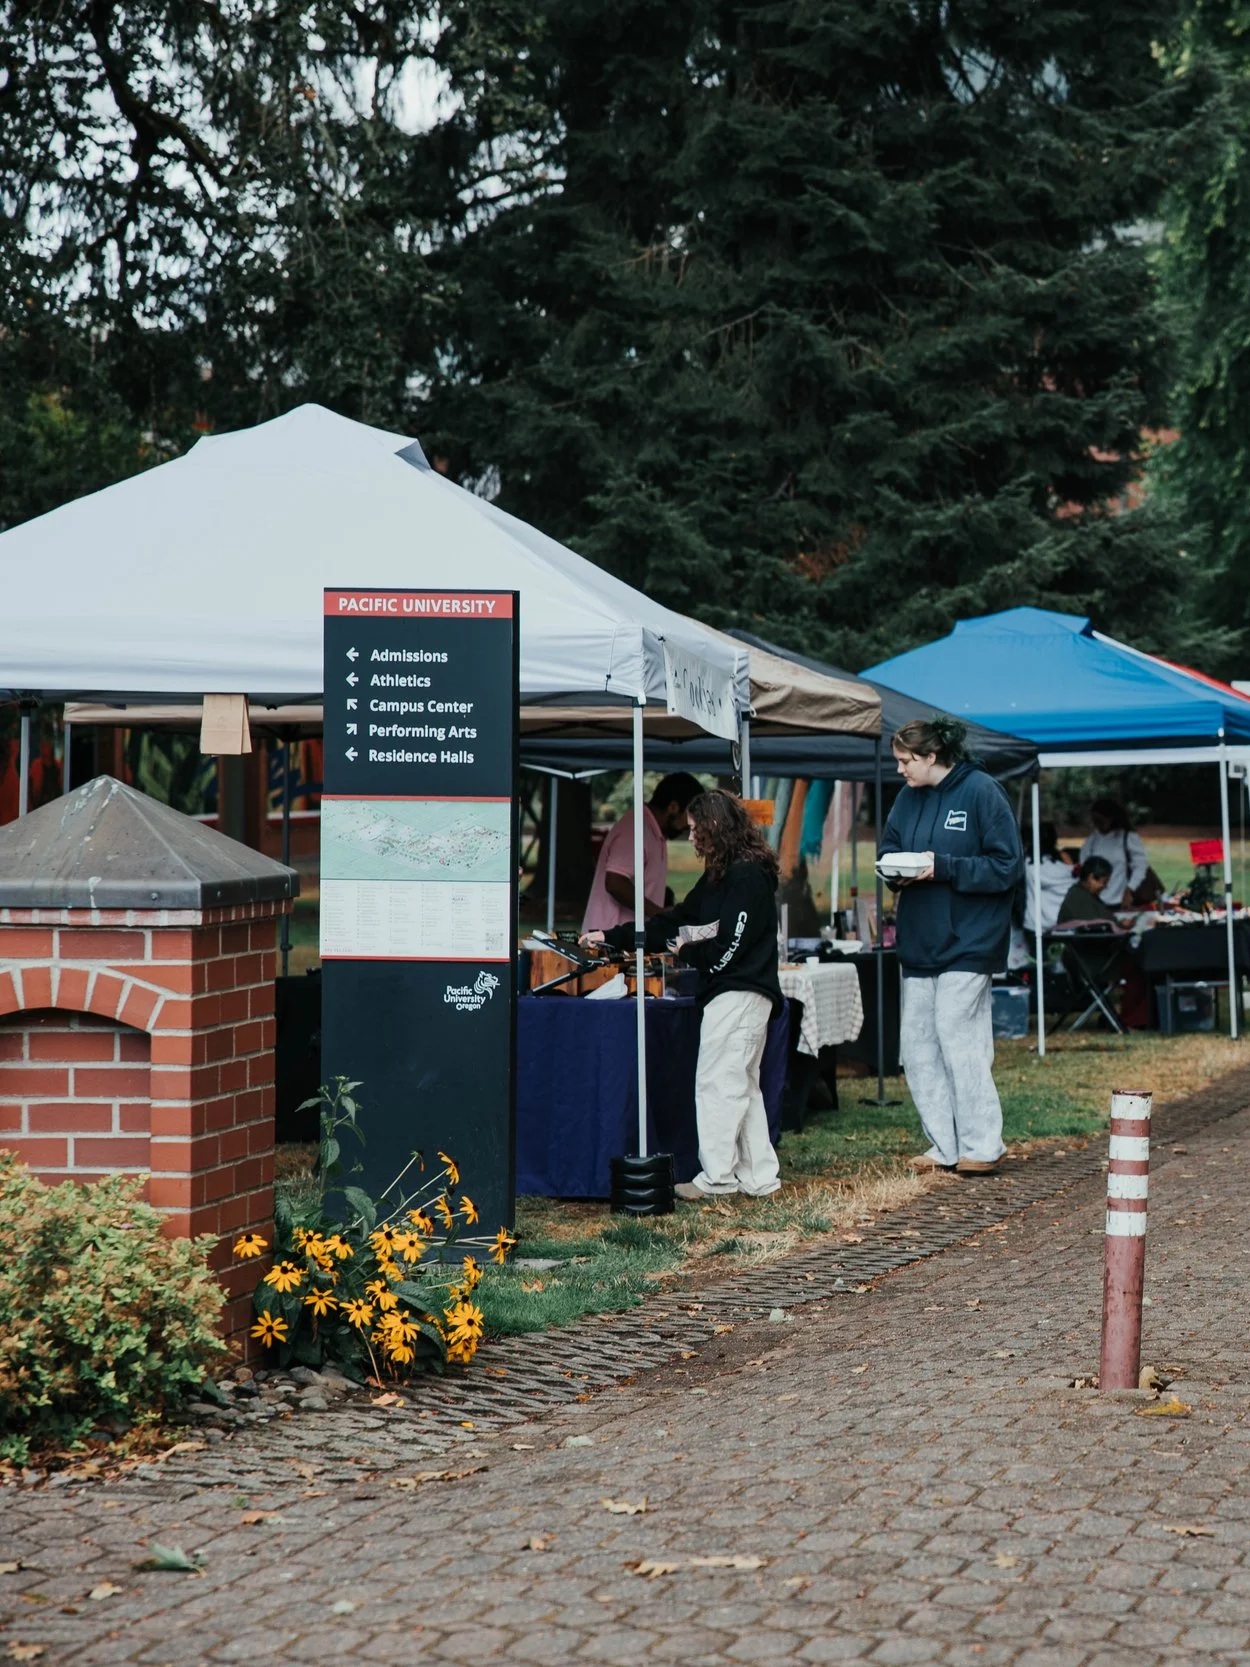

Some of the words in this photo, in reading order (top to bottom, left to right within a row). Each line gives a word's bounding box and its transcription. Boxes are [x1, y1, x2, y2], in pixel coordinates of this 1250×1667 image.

[338, 597, 398, 612] PACIFIC
[402, 599, 496, 614] UNIVERSITY
[370, 649, 448, 663] Admissions
[370, 674, 431, 687] Athletics
[369, 699, 424, 715] Campus
[427, 700, 474, 714] Center
[369, 724, 446, 741] Performing
[448, 725, 477, 739] Arts
[369, 749, 437, 762] Residence
[440, 750, 474, 764] Halls
[709, 911, 748, 974] carhart
[446, 985, 473, 995] Pacific
[443, 993, 486, 1005] University
[456, 1003, 481, 1011] Oregon
